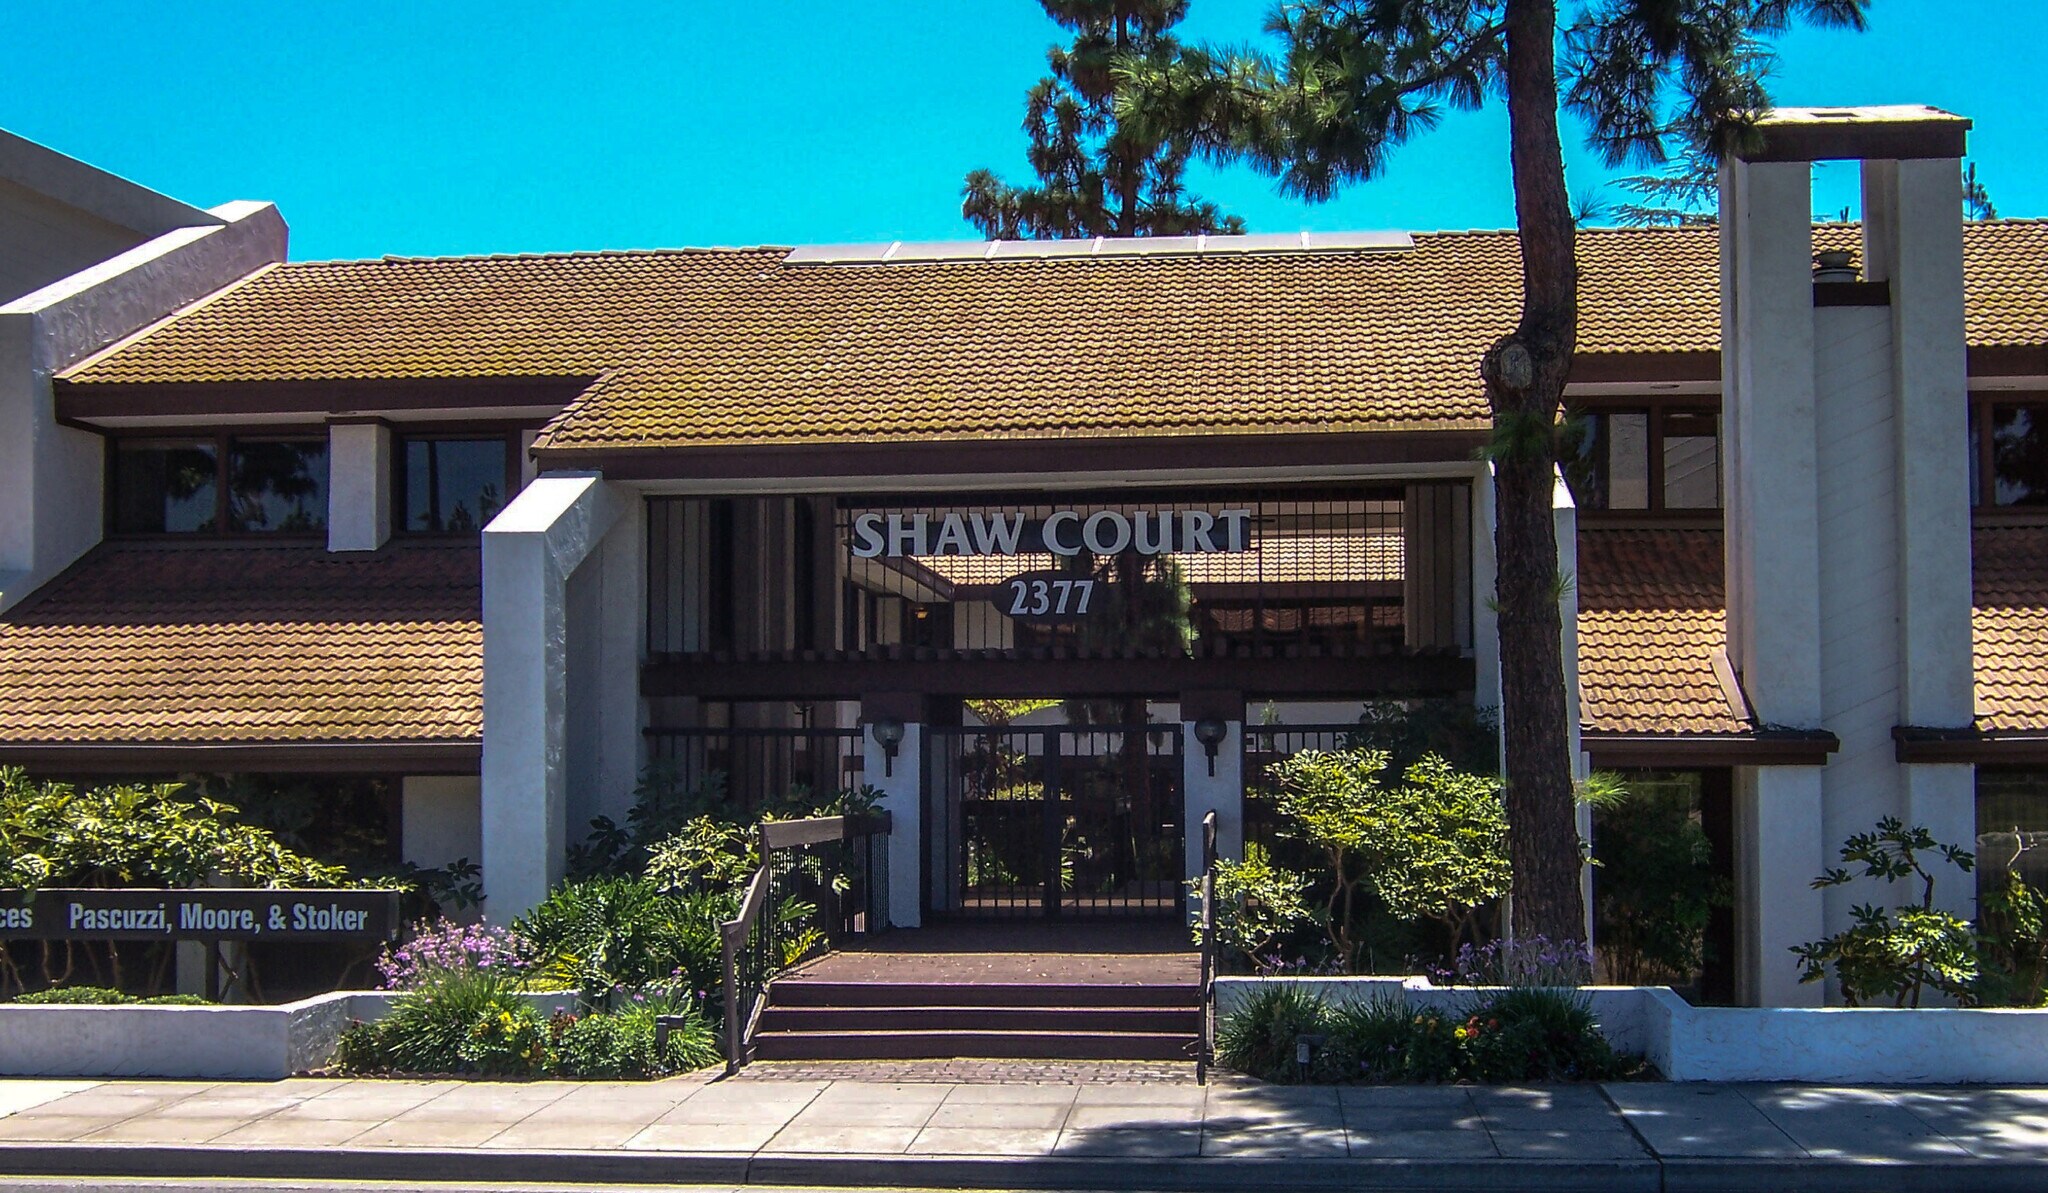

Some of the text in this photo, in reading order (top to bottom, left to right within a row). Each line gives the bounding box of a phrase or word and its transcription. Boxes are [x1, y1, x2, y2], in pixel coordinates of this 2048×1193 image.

[852, 509, 1251, 557] SHAW COURT
[1009, 580, 1094, 615] 2377
[69, 903, 368, 934] Pascuzzi, Moore, & Stoker
